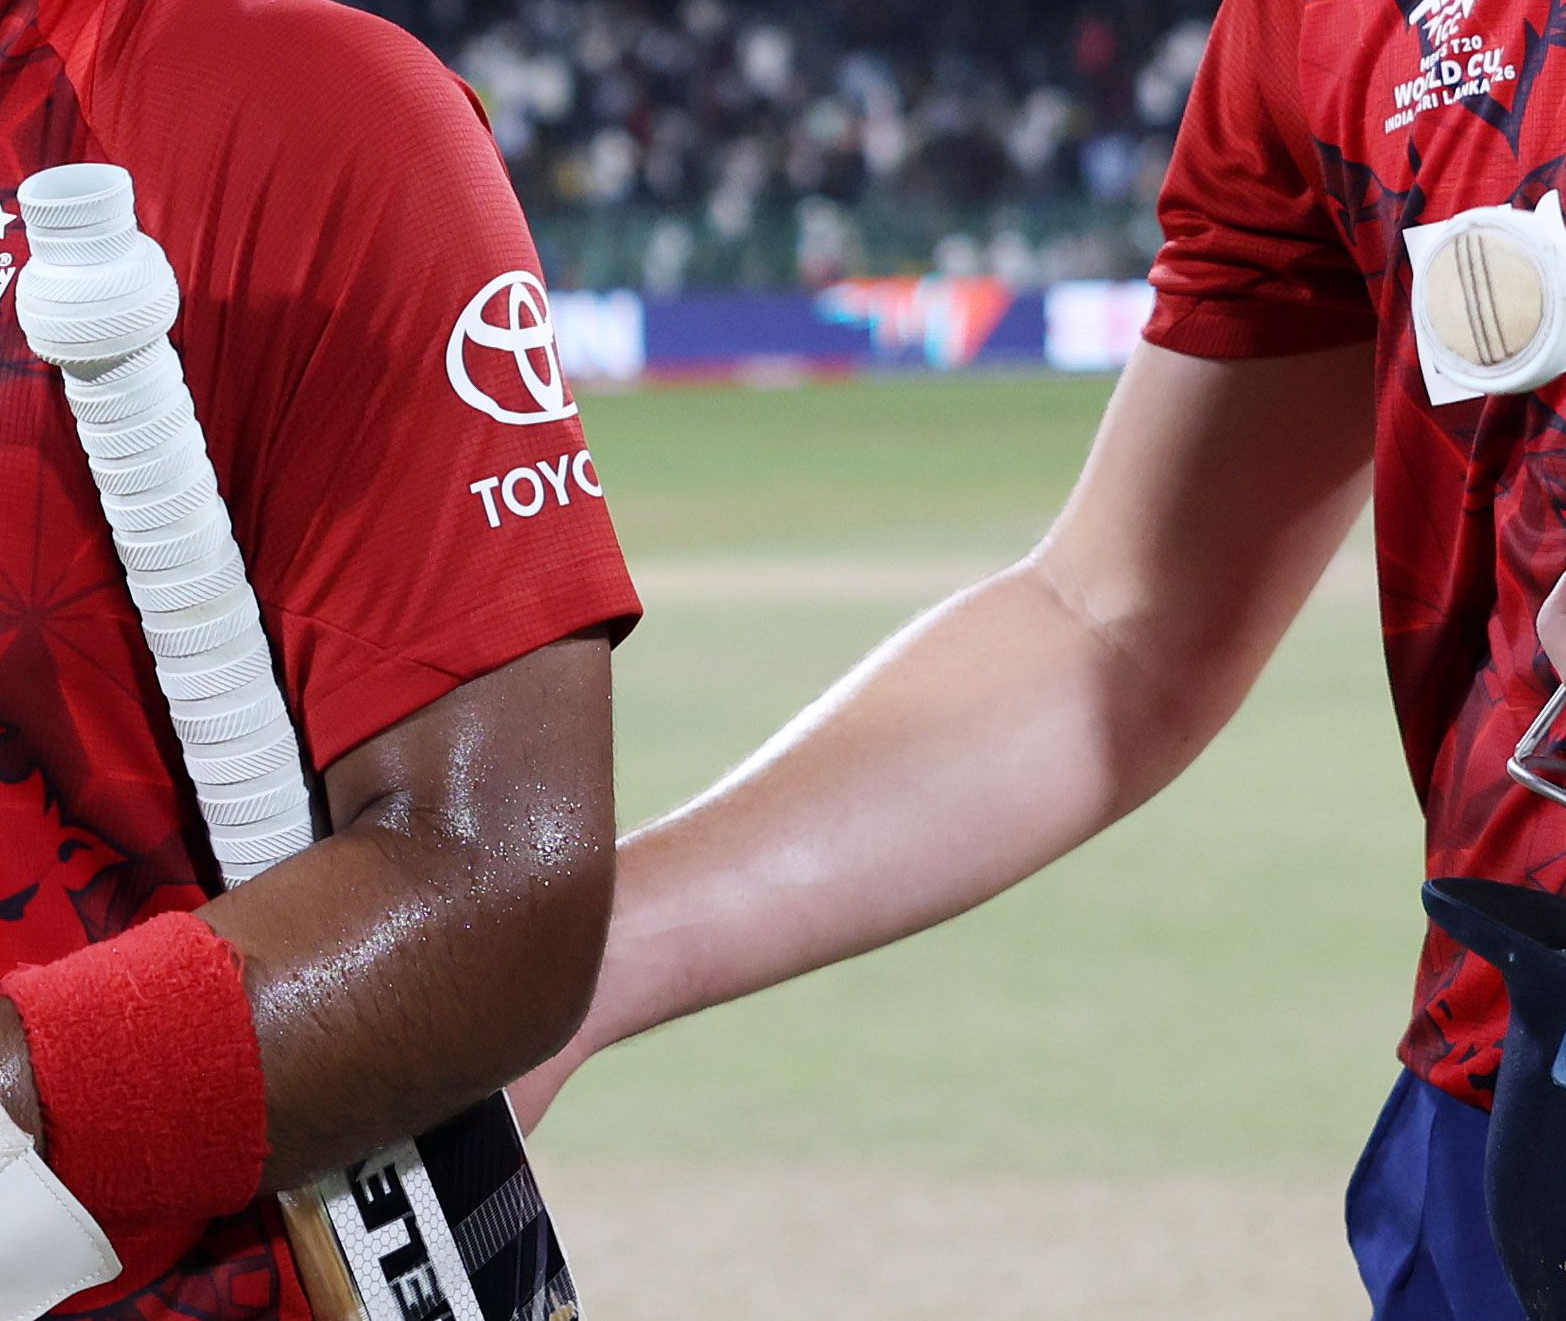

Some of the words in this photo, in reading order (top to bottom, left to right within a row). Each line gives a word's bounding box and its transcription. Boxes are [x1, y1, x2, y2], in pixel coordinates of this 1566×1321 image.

[1450, 35, 1483, 54] T20
[1394, 60, 1462, 109] WOLD
[1467, 46, 1505, 77] CU
